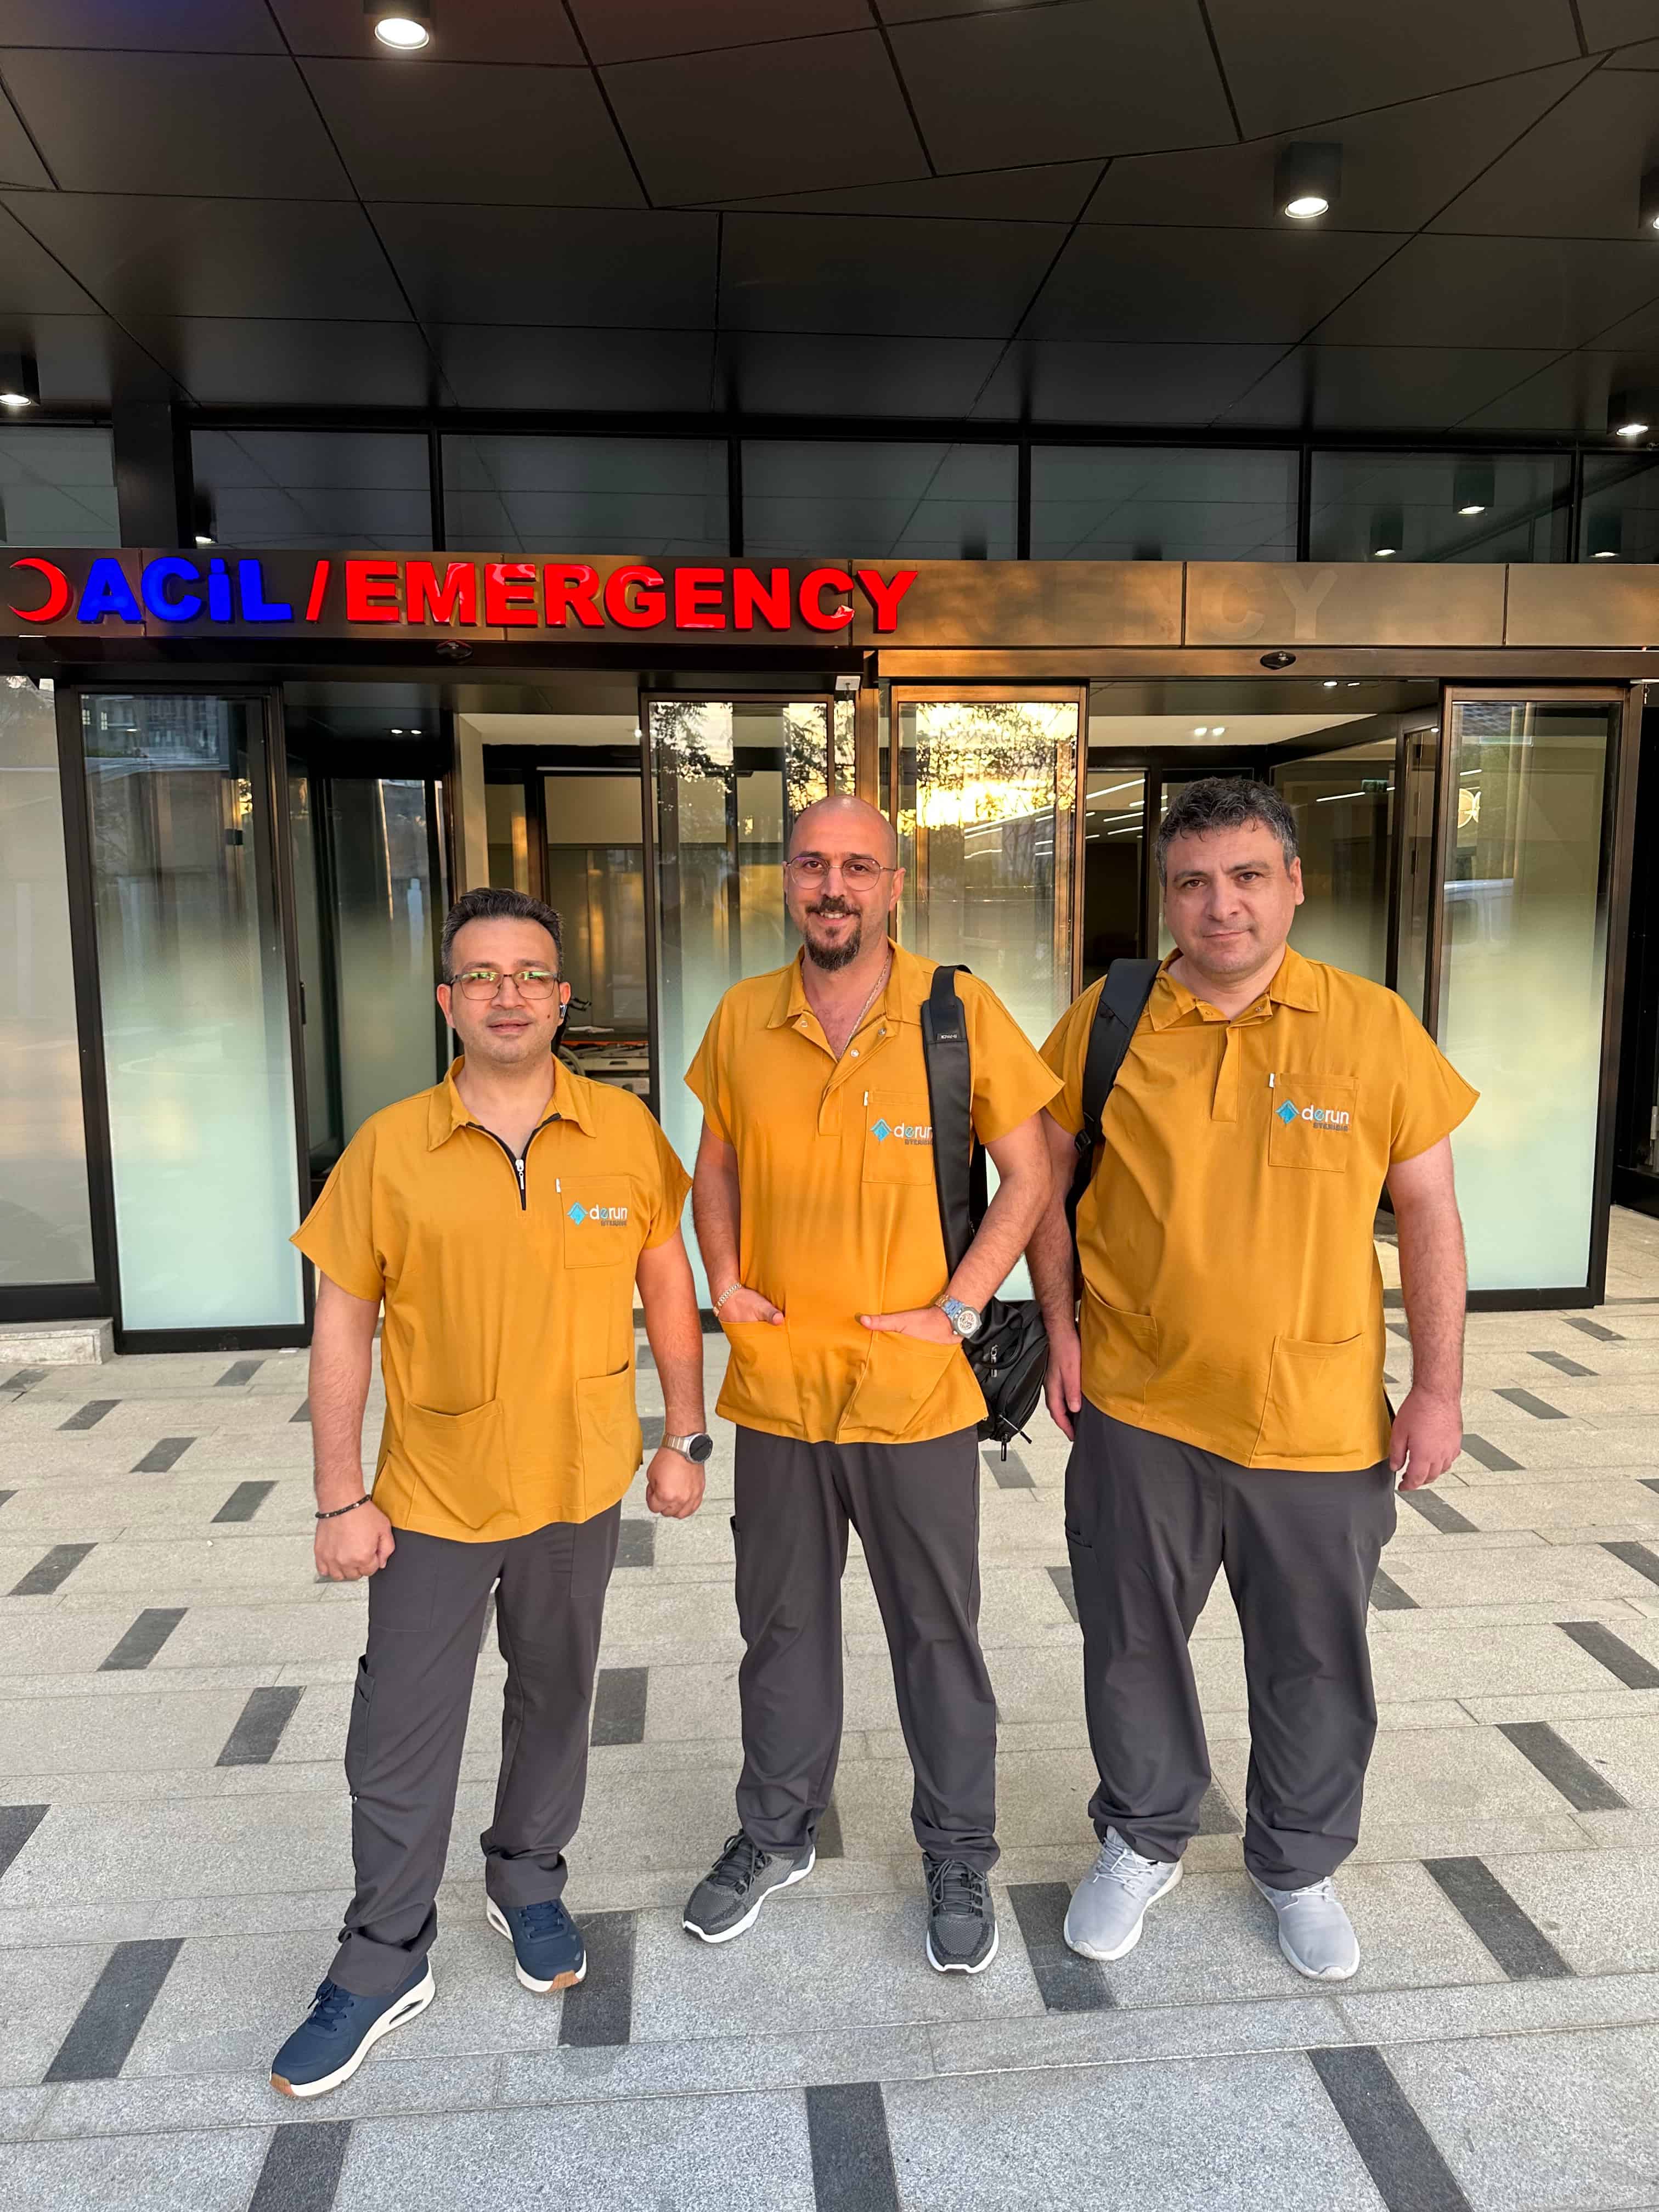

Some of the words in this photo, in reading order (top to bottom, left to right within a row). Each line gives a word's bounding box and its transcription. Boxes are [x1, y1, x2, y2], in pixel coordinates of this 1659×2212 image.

[304, 560, 330, 623] /
[345, 560, 918, 634] EMERGENCY
[1301, 1104, 1349, 1124] derun
[589, 1204, 628, 1220] derun
